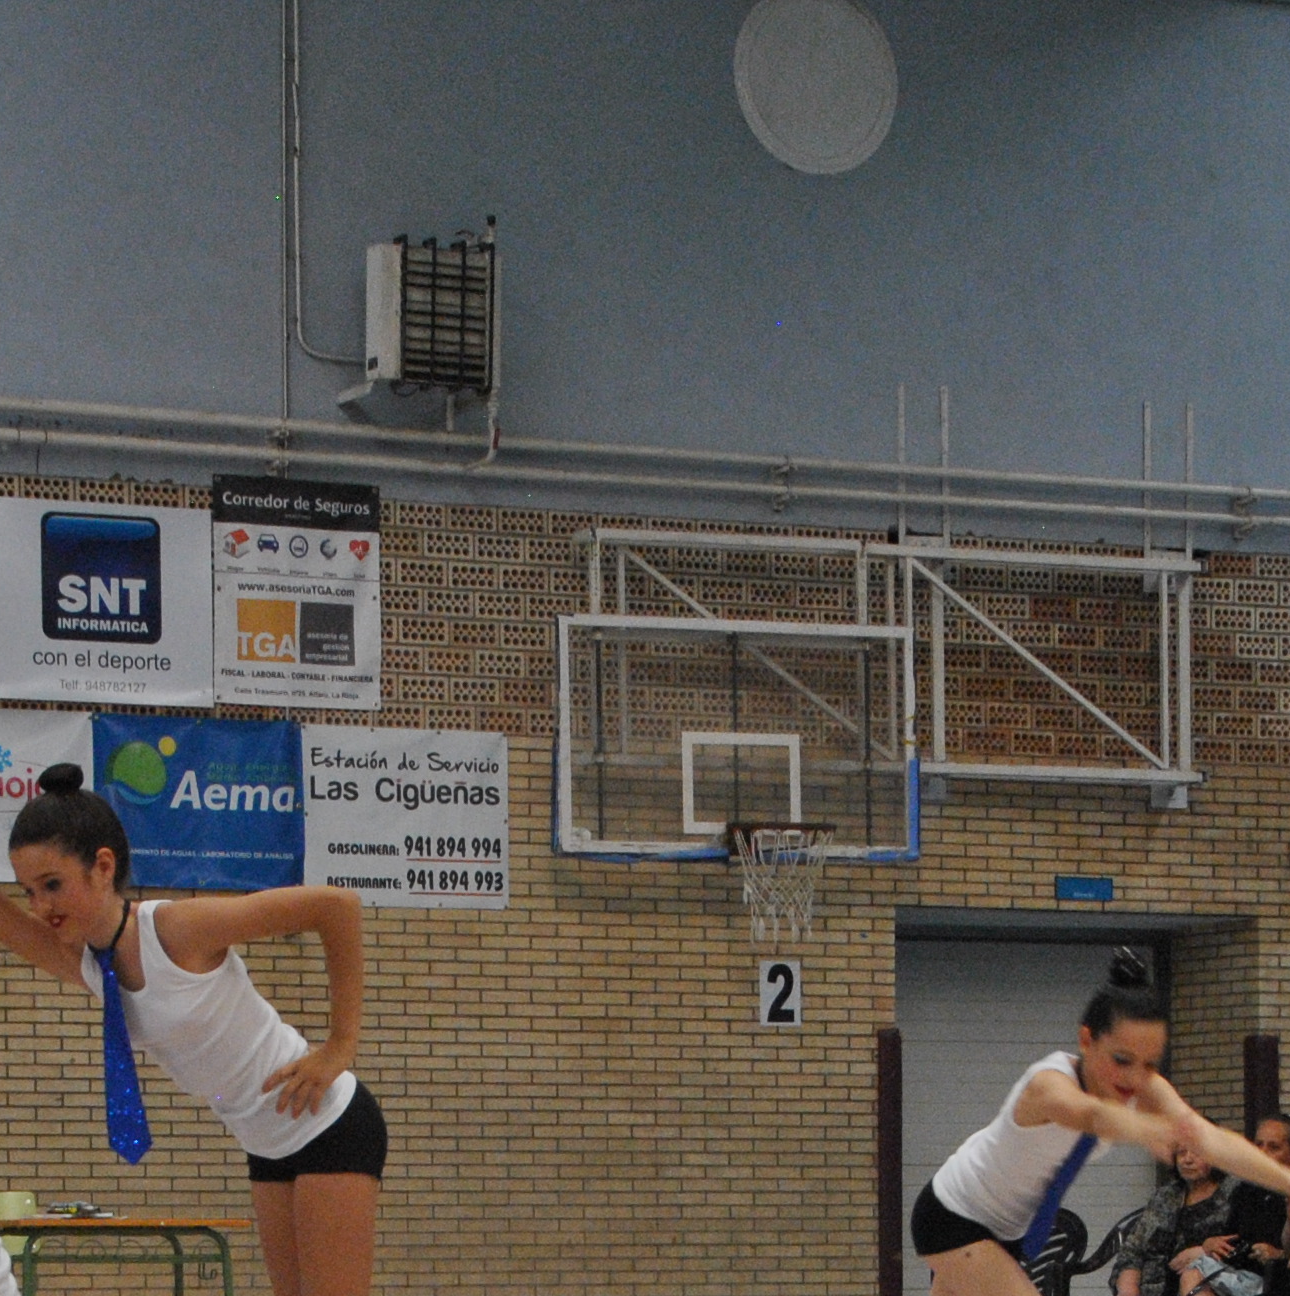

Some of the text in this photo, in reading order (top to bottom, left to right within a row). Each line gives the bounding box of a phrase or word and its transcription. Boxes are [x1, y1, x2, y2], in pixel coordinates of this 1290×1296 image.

[222, 491, 288, 510] Corredor
[294, 496, 310, 511] de
[314, 499, 370, 517] Seguros
[57, 574, 147, 616] SNT
[237, 581, 356, 598] www.asesoriaTGA.com
[57, 617, 149, 633] INFORMATICA
[238, 631, 296, 659] TGA
[32, 649, 172, 673] con el deporte
[84, 680, 147, 693] 948782127
[221, 667, 374, 684] FISCAL LABORAL CONTABLE FINANCIERA
[310, 746, 500, 774] Estación de Servicio
[169, 770, 296, 813] Aema
[310, 775, 501, 811] Las Cigüeñas
[403, 835, 432, 857] 941
[436, 836, 466, 858] 894
[471, 837, 502, 859] 994
[406, 868, 434, 891] 941
[439, 870, 469, 891] 894
[474, 871, 504, 892] 993
[766, 962, 796, 1025] 2
